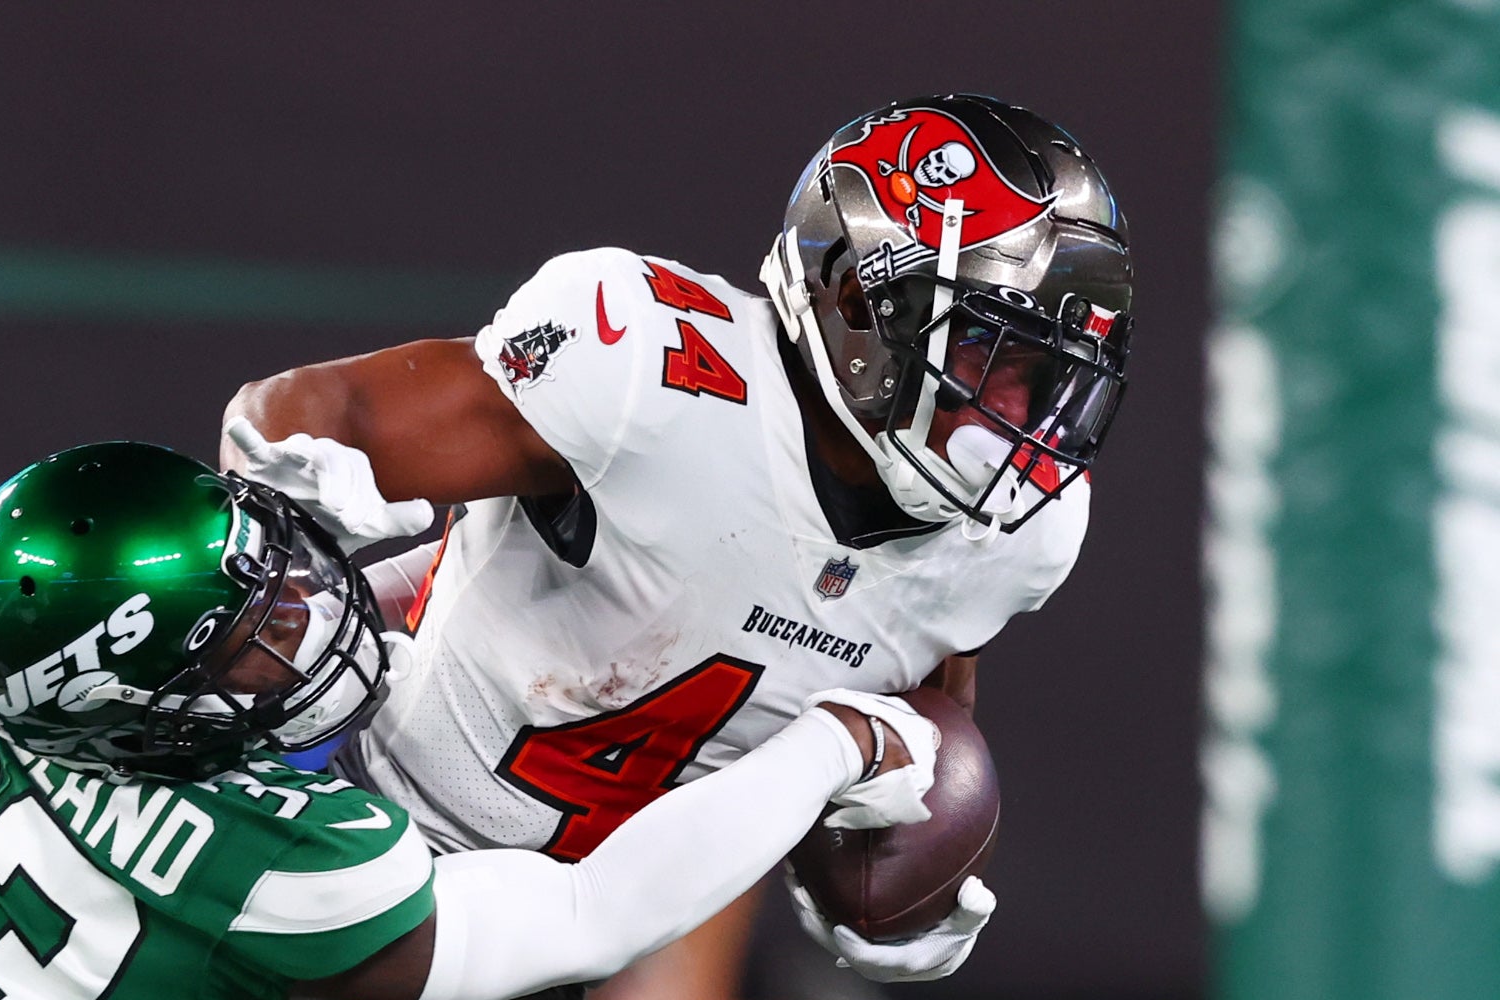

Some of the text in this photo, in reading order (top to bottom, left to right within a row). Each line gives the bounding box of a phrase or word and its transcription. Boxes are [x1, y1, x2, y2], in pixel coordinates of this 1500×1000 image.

[641, 258, 747, 406] 44
[820, 574, 845, 594] NFL
[741, 604, 873, 668] BUCCANEERS
